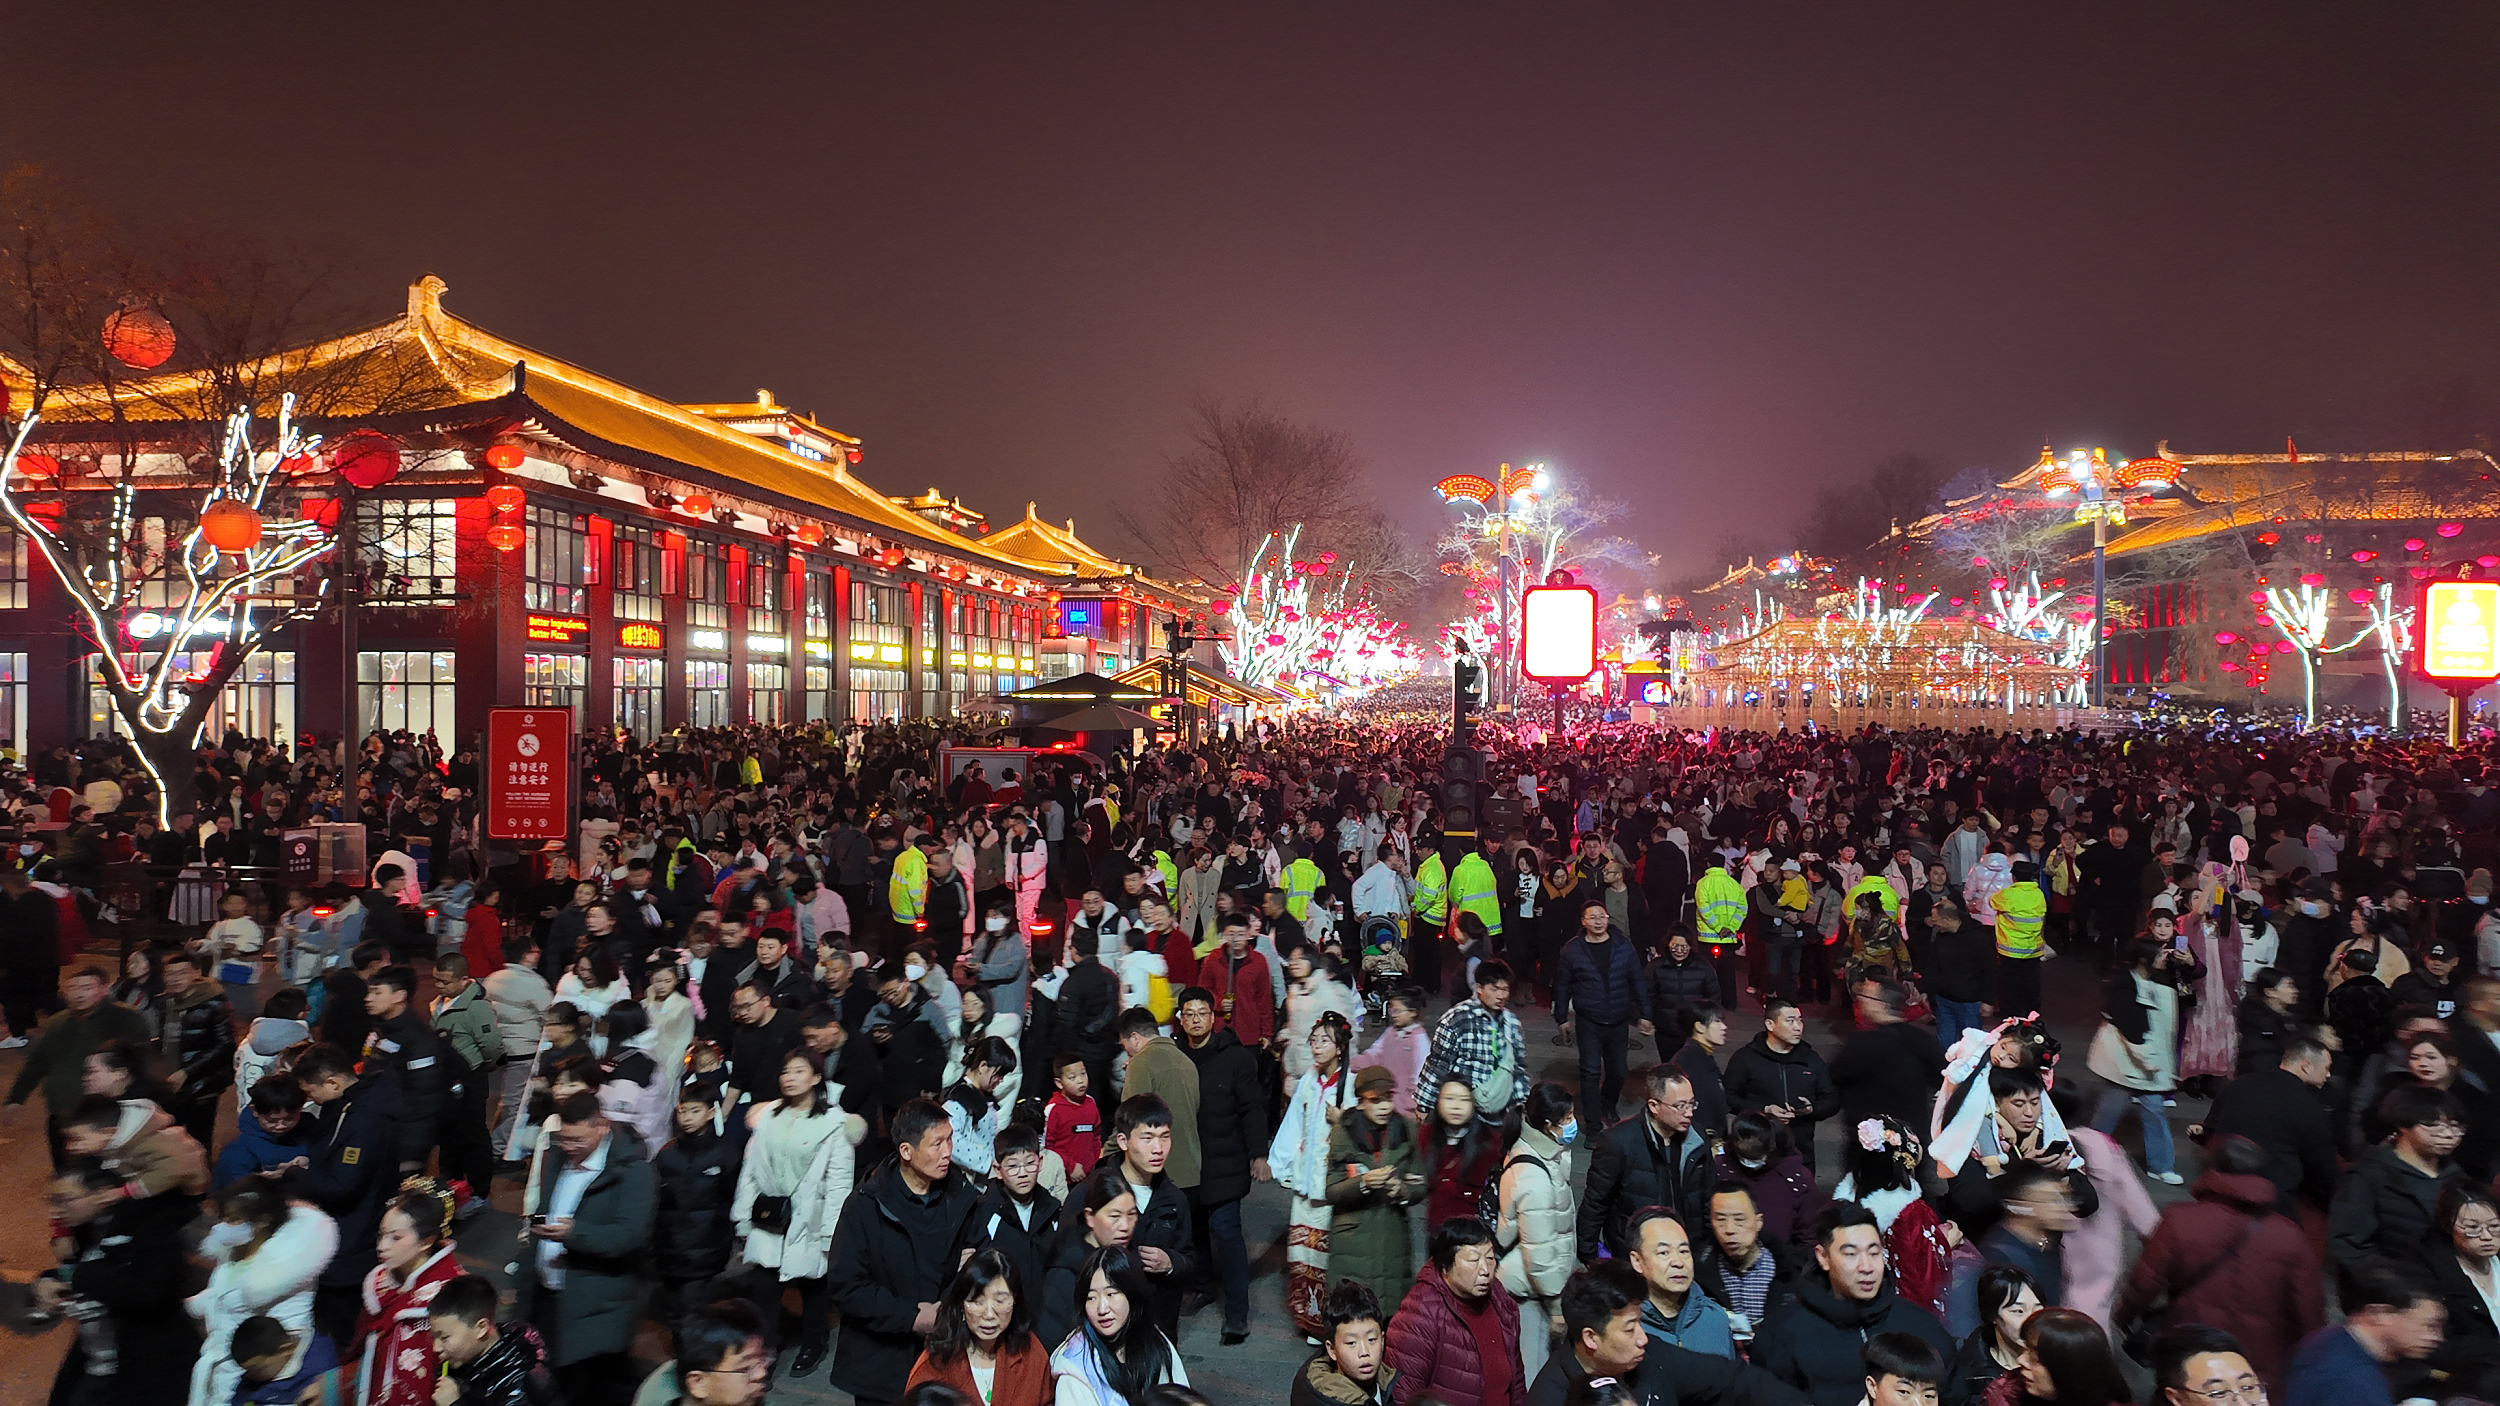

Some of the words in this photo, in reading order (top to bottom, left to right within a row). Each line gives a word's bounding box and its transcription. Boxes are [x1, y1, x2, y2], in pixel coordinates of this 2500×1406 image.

[529, 616, 550, 627] Better
[550, 618, 588, 630] Ingredients.
[529, 628, 550, 639] Better
[550, 629, 570, 641] Pizza.
[508, 761, 549, 773] 请勿逆行
[508, 774, 549, 786] 注意安全
